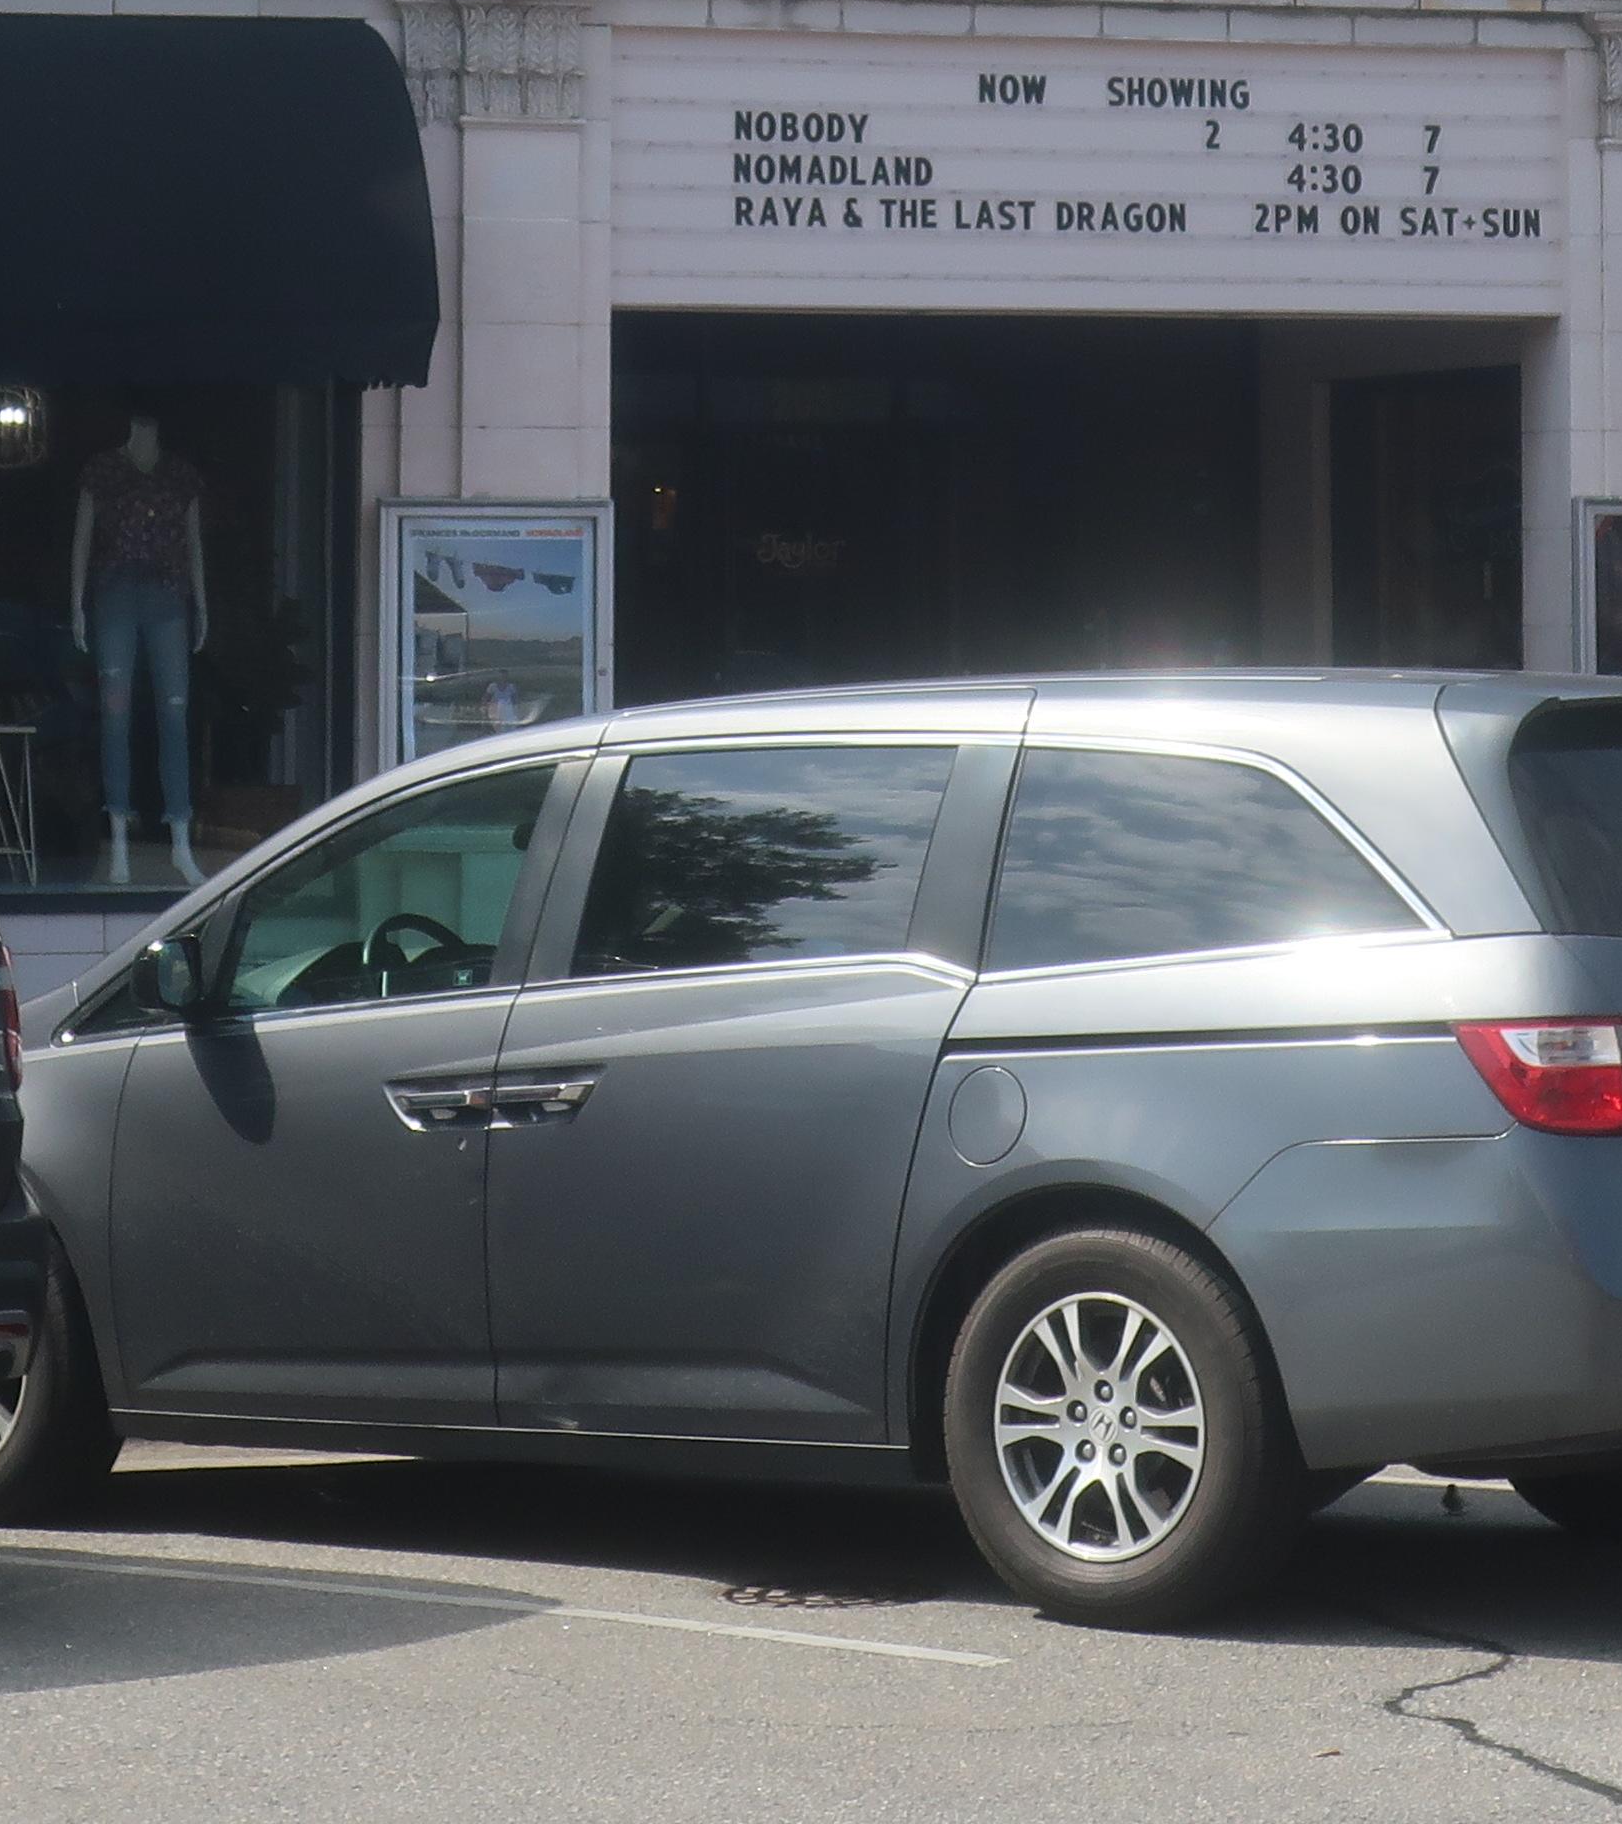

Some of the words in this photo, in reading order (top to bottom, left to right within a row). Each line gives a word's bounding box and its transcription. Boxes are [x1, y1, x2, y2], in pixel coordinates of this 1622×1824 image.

[979, 73, 1046, 105] NOW
[1107, 76, 1250, 110] SHOWING
[734, 110, 868, 144] NOBODY
[1206, 120, 1220, 149] 2
[1288, 122, 1363, 153] 4:30
[1424, 125, 1441, 154] 7
[733, 153, 933, 187] NOMADLAND
[1287, 163, 1362, 195] 4:30
[1423, 165, 1440, 195] 7
[735, 196, 827, 227] RAYA
[843, 197, 863, 228] &
[879, 198, 937, 229] THE
[955, 199, 1036, 231] LAST
[1056, 201, 1186, 233] DRAGON
[1255, 203, 1319, 234] 2PM
[1340, 205, 1380, 236] ON
[1400, 206, 1540, 238] SAT+SUN
